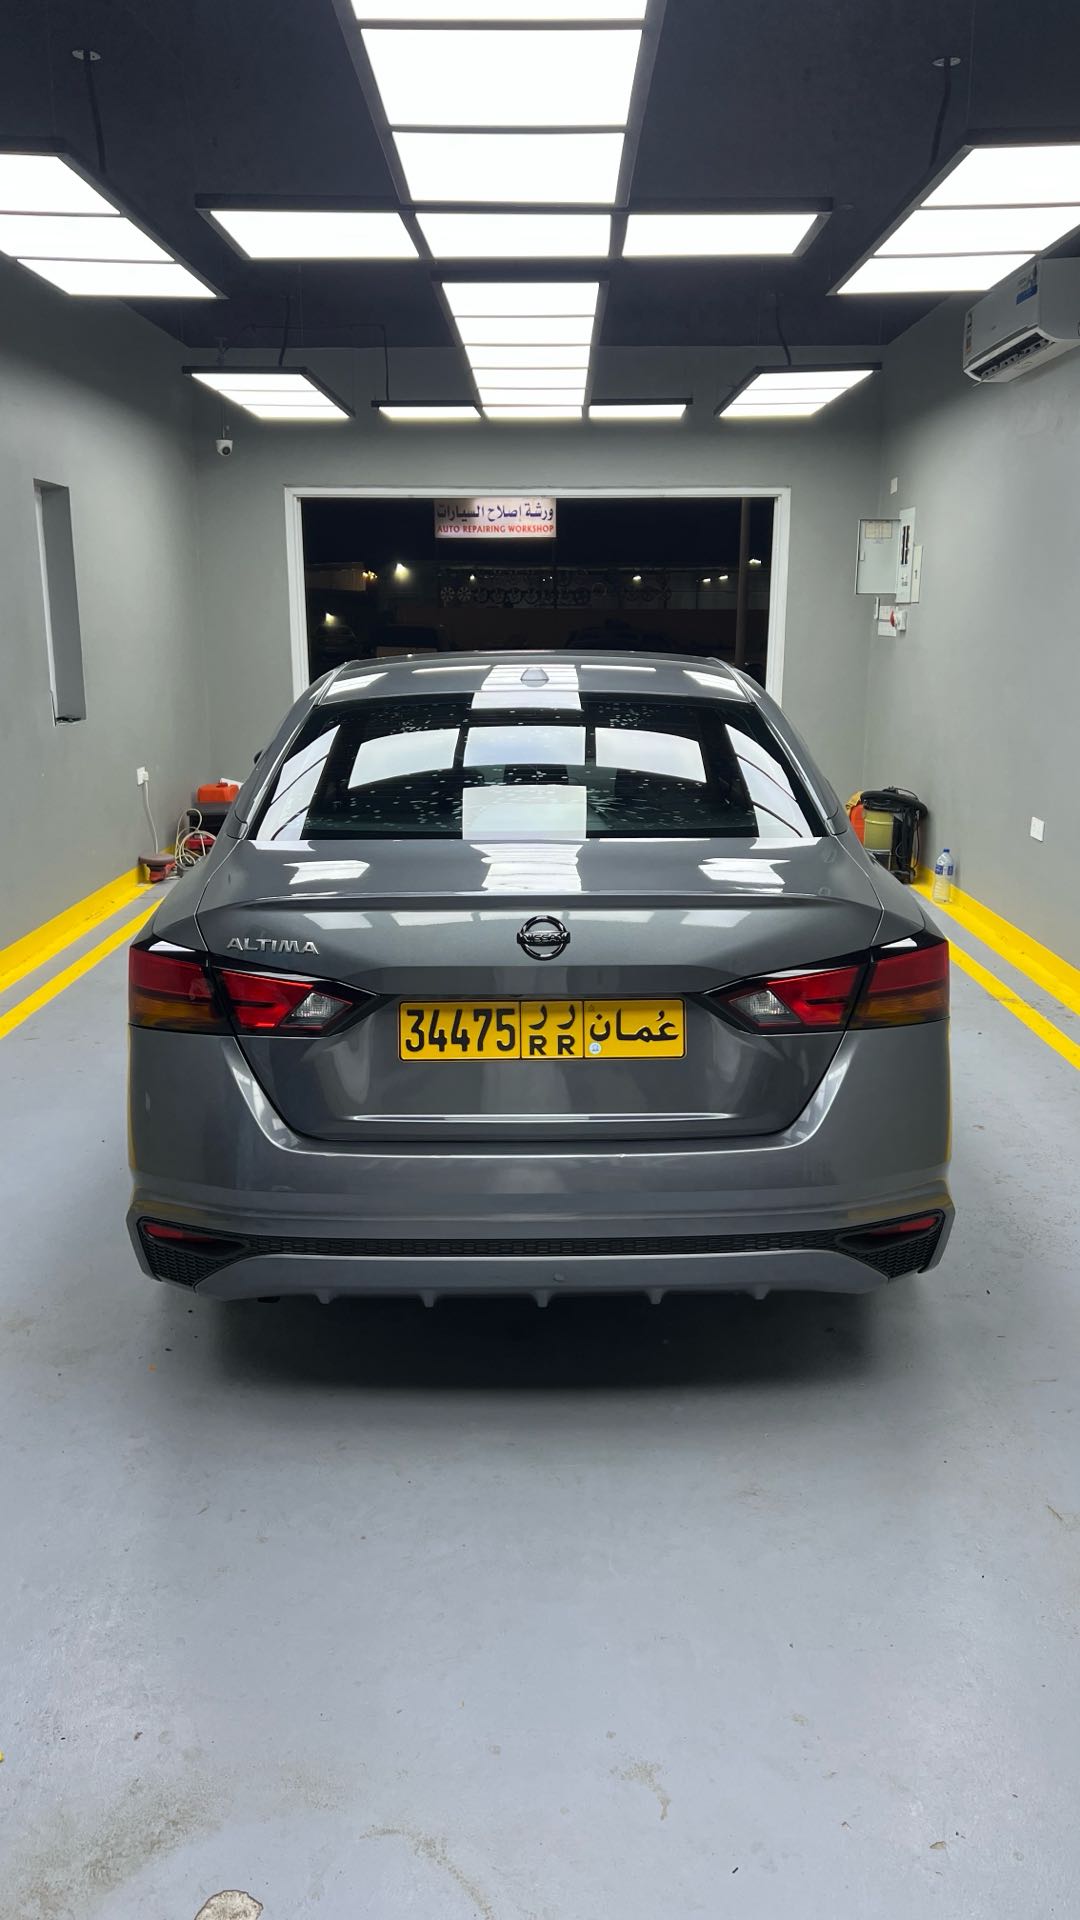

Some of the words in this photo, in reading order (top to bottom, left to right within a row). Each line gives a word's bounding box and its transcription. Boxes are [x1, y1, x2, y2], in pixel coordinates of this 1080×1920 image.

[525, 502, 554, 520] ورشة
[437, 525, 460, 533] AUTO
[463, 525, 506, 533] REPAIRING
[508, 525, 554, 533] WORKSHOP
[226, 937, 320, 955] ALTIMA
[521, 934, 566, 944] NISSAN
[405, 1009, 516, 1052] 34475
